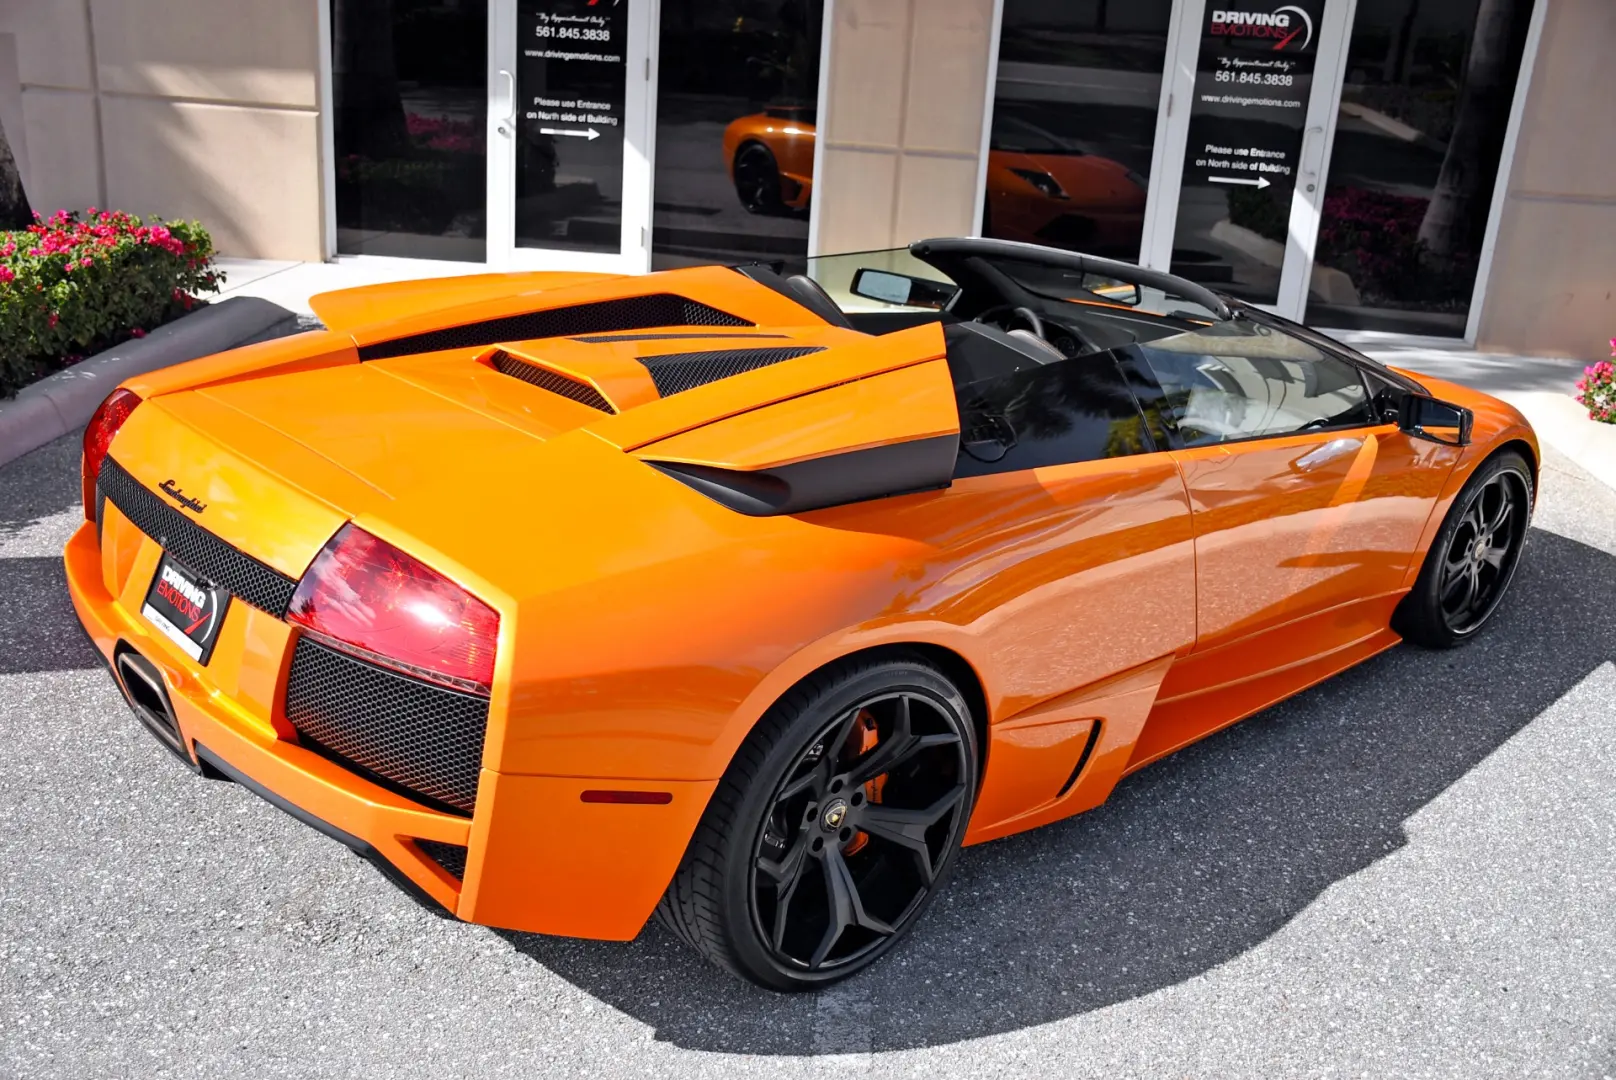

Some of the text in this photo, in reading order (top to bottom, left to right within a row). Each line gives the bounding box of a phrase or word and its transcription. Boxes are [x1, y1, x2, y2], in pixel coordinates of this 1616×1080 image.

[1211, 10, 1289, 27] DRIVING
[535, 25, 610, 41] 561.845.3838
[1210, 22, 1289, 38] EMOTIONS
[524, 49, 620, 62] www.drivingemotions.com
[1214, 69, 1293, 86] 561.845.3838
[533, 97, 611, 110] Please use Entrance
[1200, 94, 1301, 108] www.drivingemotions.com
[526, 111, 618, 125] on North side of Building
[1204, 143, 1285, 158] Please use Entrance
[1195, 158, 1290, 175] on North side of Building
[160, 564, 206, 609] DRIVING
[156, 578, 201, 622] EMOTIONS
